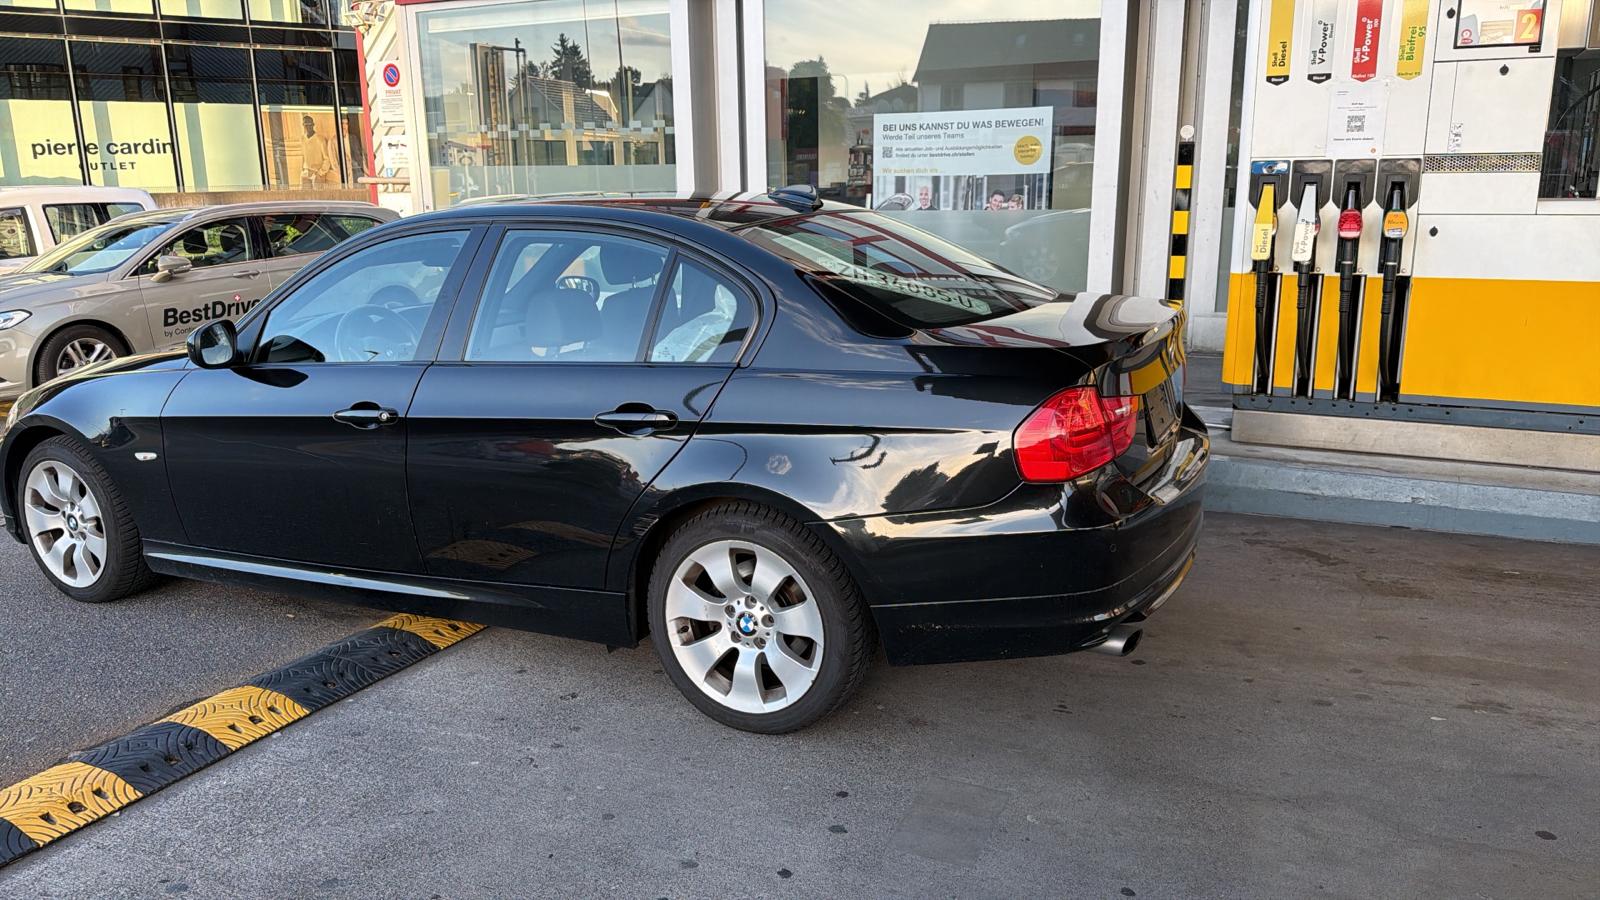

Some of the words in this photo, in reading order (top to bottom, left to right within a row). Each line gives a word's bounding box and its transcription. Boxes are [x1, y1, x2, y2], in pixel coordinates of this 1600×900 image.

[1418, 26, 1427, 37] 95
[1519, 13, 1537, 39] 2
[1317, 22, 1329, 65] V-Power
[1361, 19, 1373, 63] V-Power
[1406, 26, 1417, 61] Bleifrei
[1278, 41, 1287, 67] Diesel
[882, 124, 897, 132] BEI
[899, 123, 917, 132] UNS
[919, 122, 955, 131] KANNST
[956, 121, 970, 130] DU
[972, 120, 993, 129] WAS
[995, 118, 1044, 128] BEWEGEN!
[31, 139, 99, 160] piere
[106, 138, 174, 155] cardin
[78, 161, 137, 171] UTLET
[1260, 229, 1269, 254] Diesel
[164, 330, 173, 338] by
